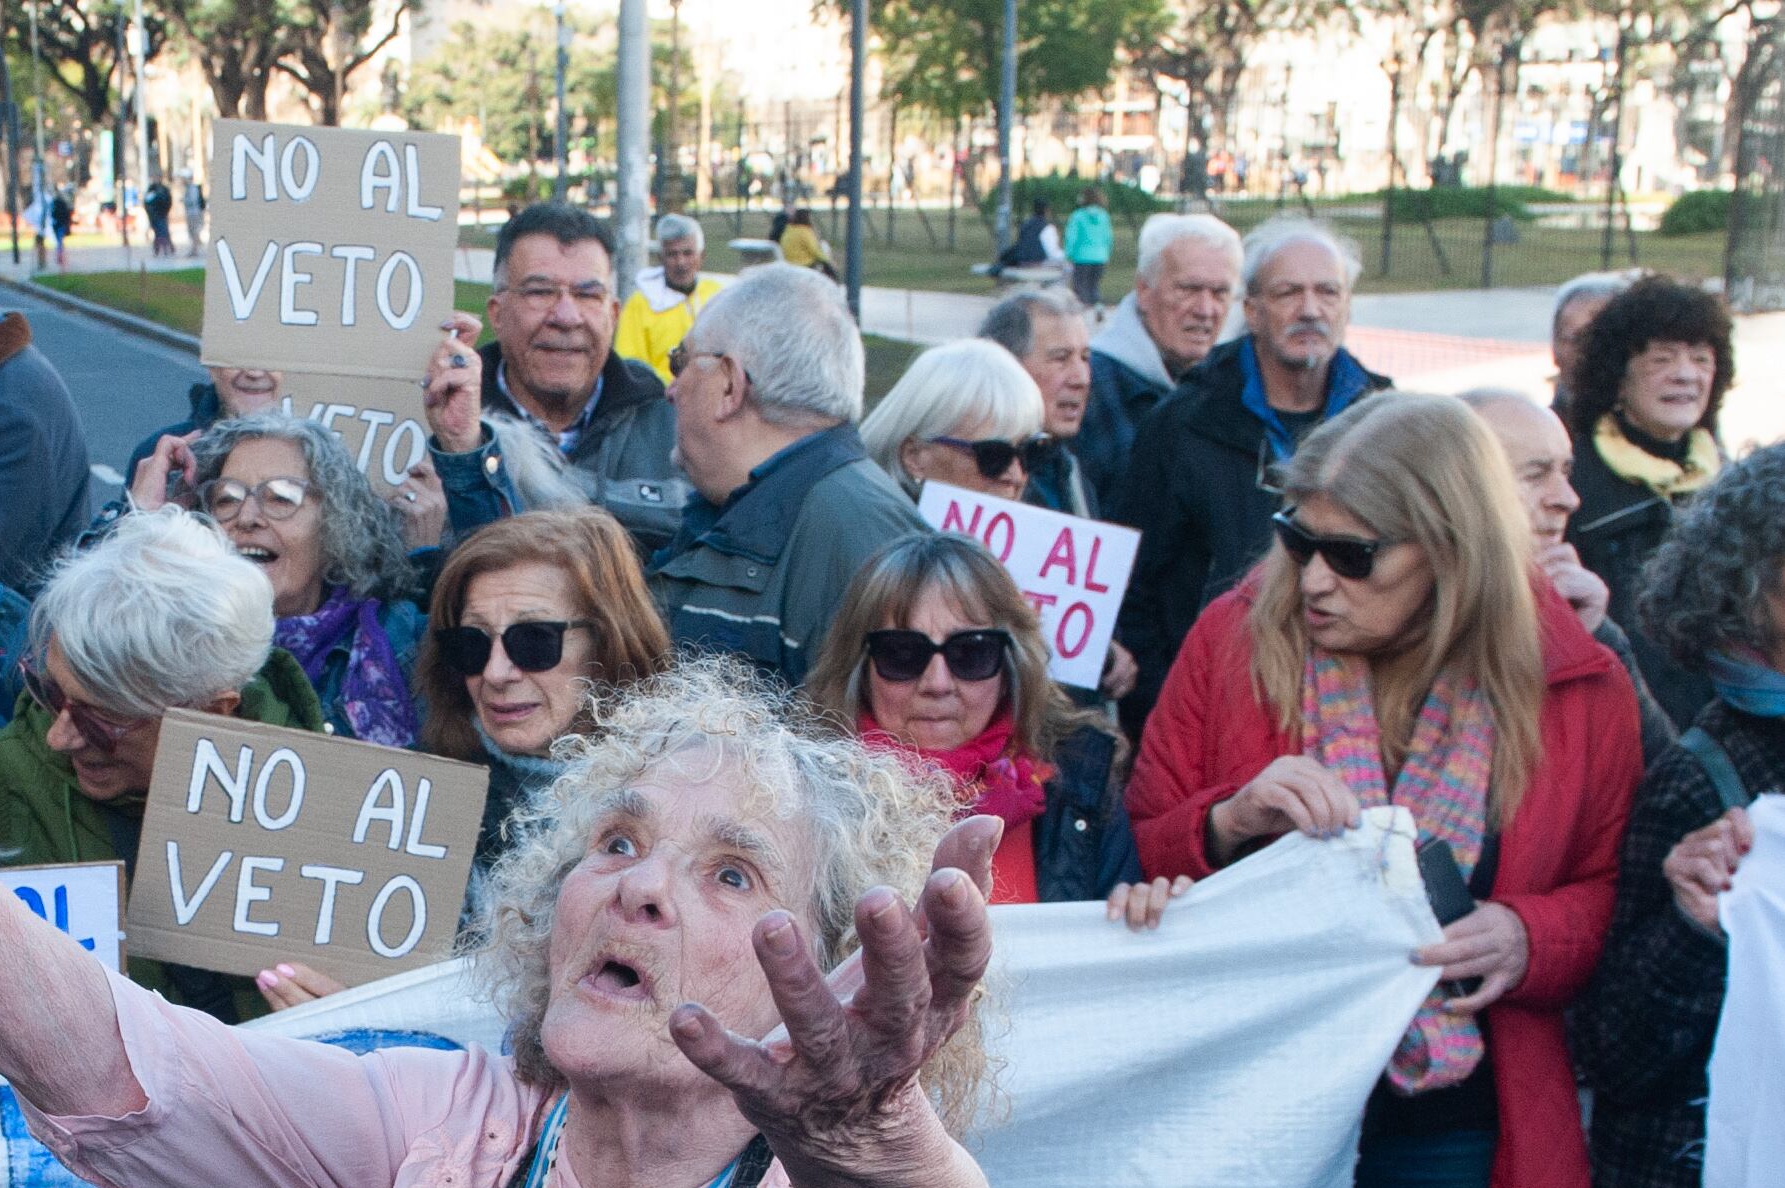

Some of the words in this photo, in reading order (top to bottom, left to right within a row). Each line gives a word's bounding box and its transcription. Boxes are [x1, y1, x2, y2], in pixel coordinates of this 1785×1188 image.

[231, 132, 320, 201] NO
[360, 140, 444, 221] AL
[216, 236, 424, 330] VETO
[282, 395, 427, 487] ETO
[1039, 526, 1109, 593] AL
[1022, 590, 1094, 660] TO
[186, 738, 306, 831] NO
[352, 768, 449, 859] AL
[165, 840, 427, 958] VETO
